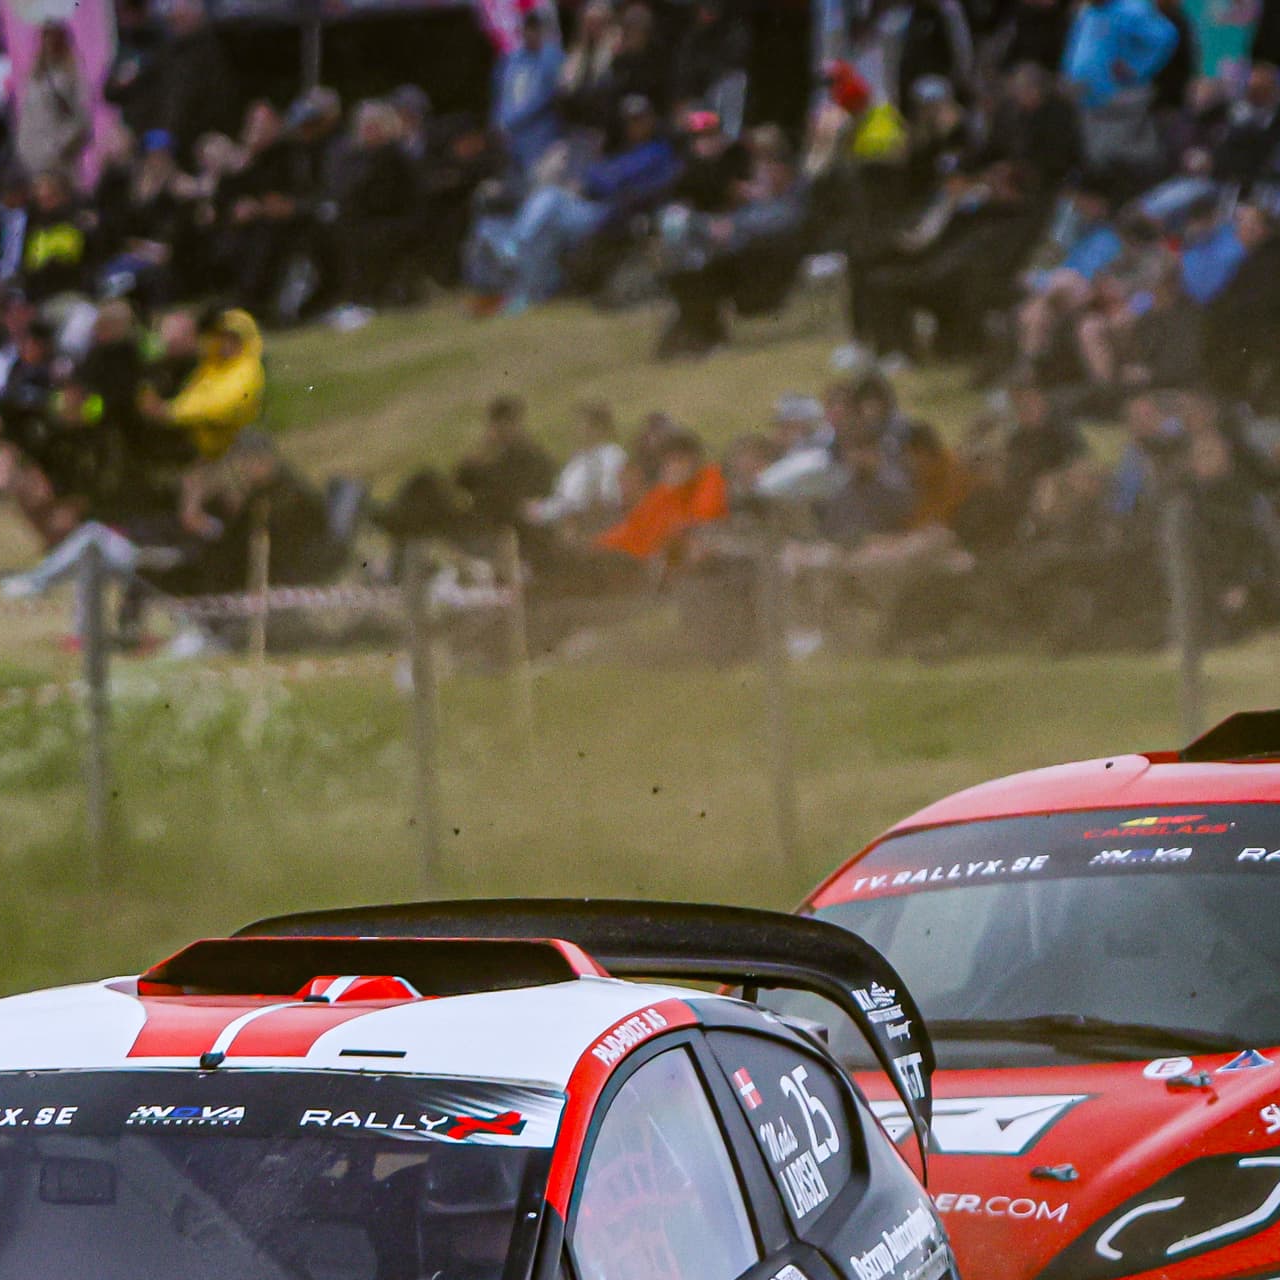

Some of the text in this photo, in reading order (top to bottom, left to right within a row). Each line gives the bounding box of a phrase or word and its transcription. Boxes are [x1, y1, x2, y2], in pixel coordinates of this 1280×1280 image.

[1083, 823, 1229, 839] CARGLASS
[853, 855, 1050, 892] TV.RALLYX.SE
[130, 1106, 245, 1119] NOVA
[780, 1065, 840, 1164] 25
[931, 1193, 1069, 1223] ER.COM
